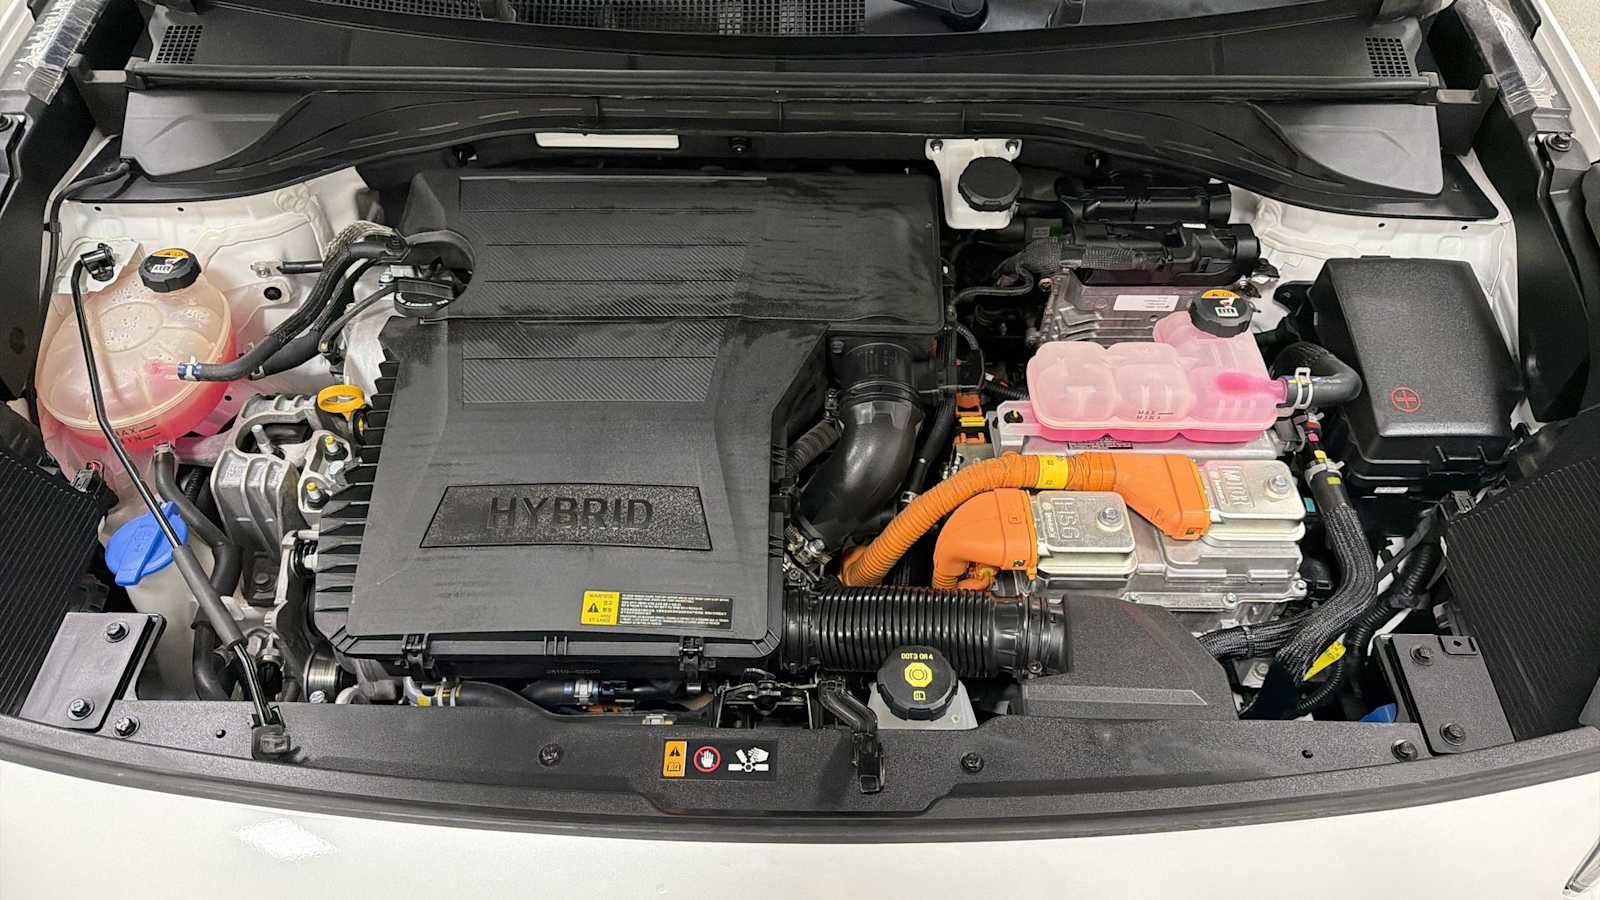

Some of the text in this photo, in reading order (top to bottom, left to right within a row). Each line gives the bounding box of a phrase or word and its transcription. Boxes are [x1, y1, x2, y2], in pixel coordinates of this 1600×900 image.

[115, 427, 138, 437] AX
[487, 497, 654, 530] HYBRID
[1055, 502, 1080, 538] HSG
